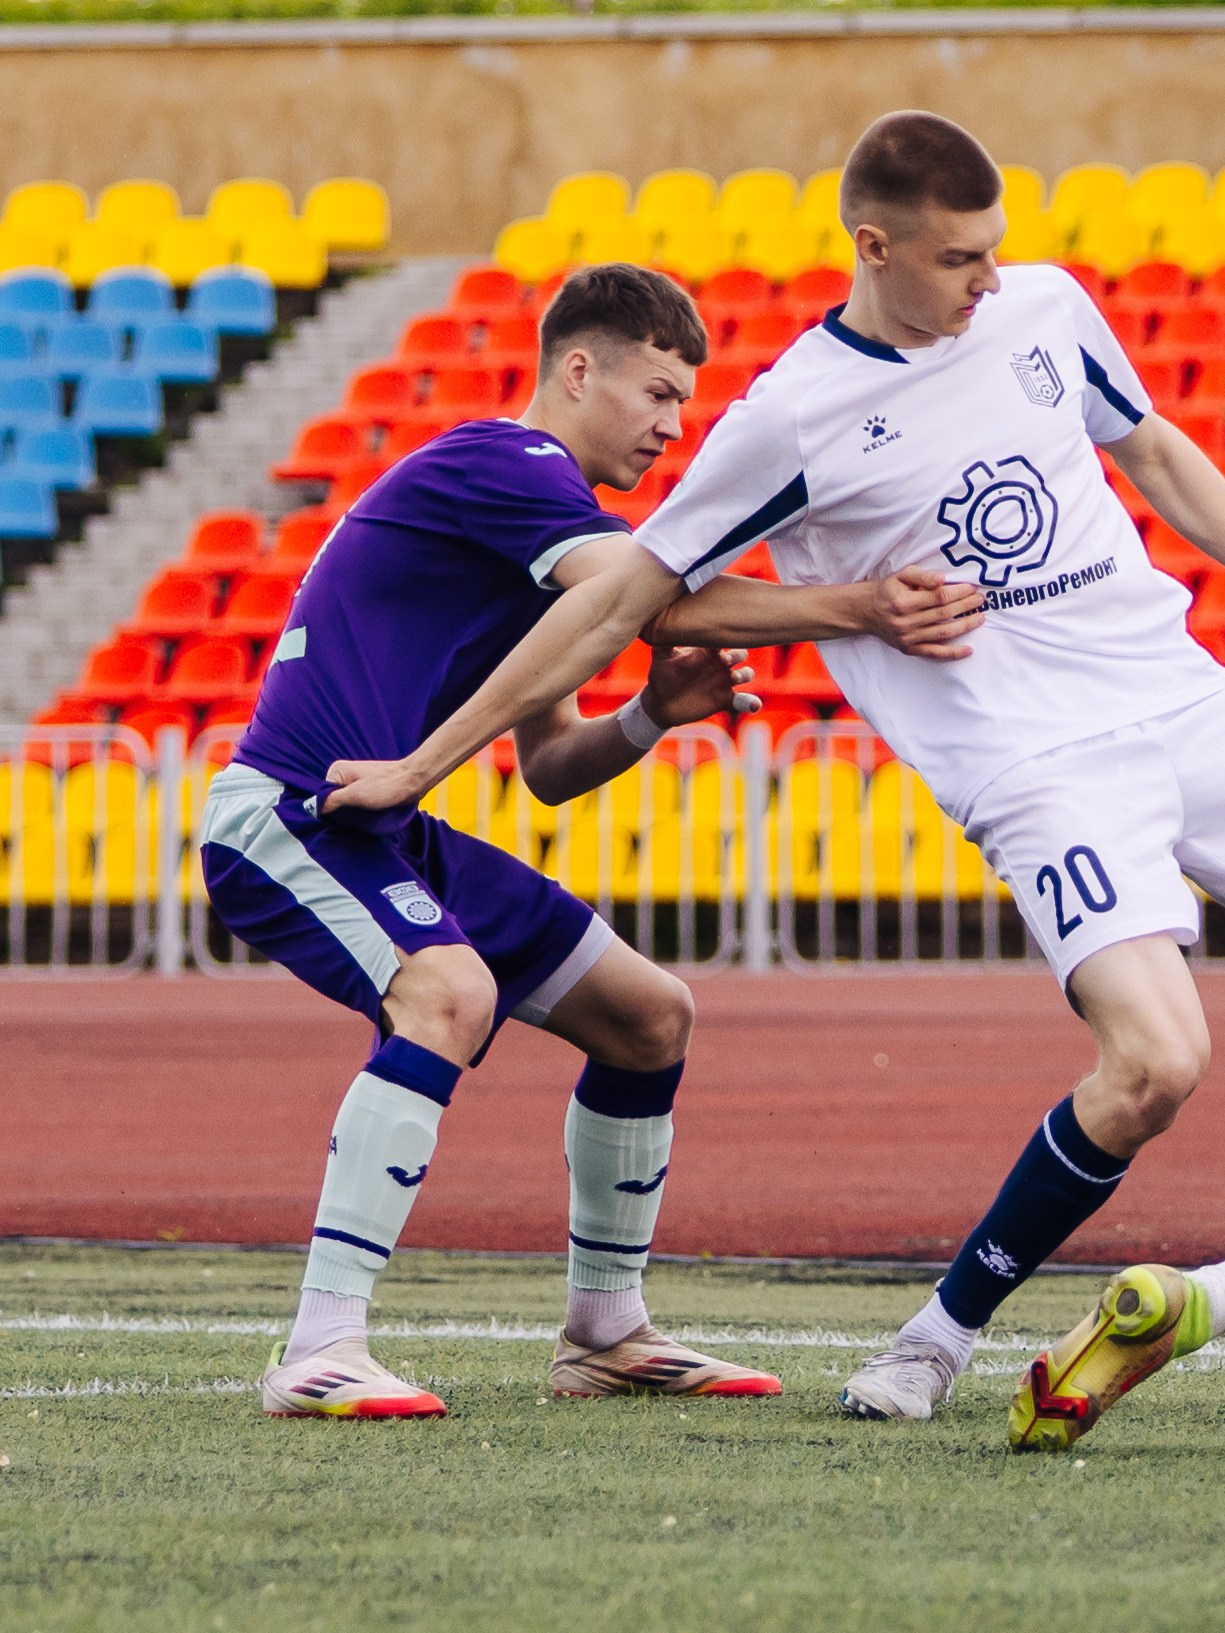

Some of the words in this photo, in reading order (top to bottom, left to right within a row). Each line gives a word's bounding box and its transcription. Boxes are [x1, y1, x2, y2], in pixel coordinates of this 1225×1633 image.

[862, 430, 902, 454] KELME
[953, 556, 1119, 619] ЭнергоРемонт
[1036, 845, 1117, 942] 20
